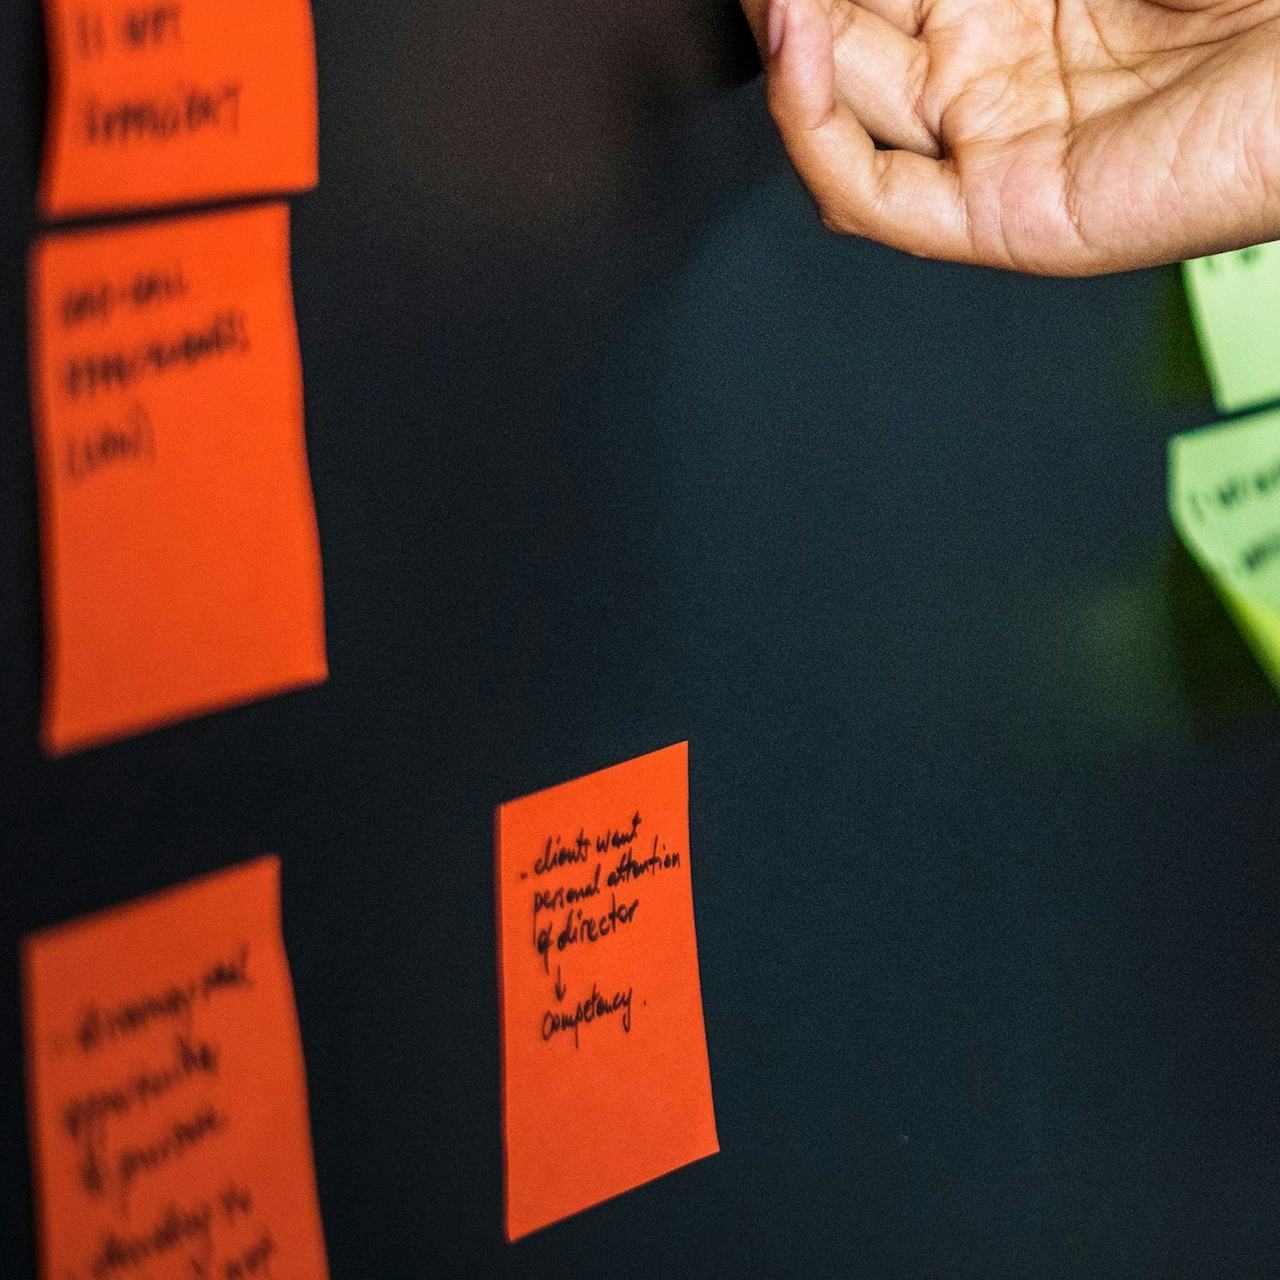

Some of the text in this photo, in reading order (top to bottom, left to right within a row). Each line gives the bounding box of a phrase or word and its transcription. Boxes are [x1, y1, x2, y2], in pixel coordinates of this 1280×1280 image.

[535, 810, 642, 875] clients want
[533, 835, 680, 946] personal attention
[557, 893, 639, 951] director
